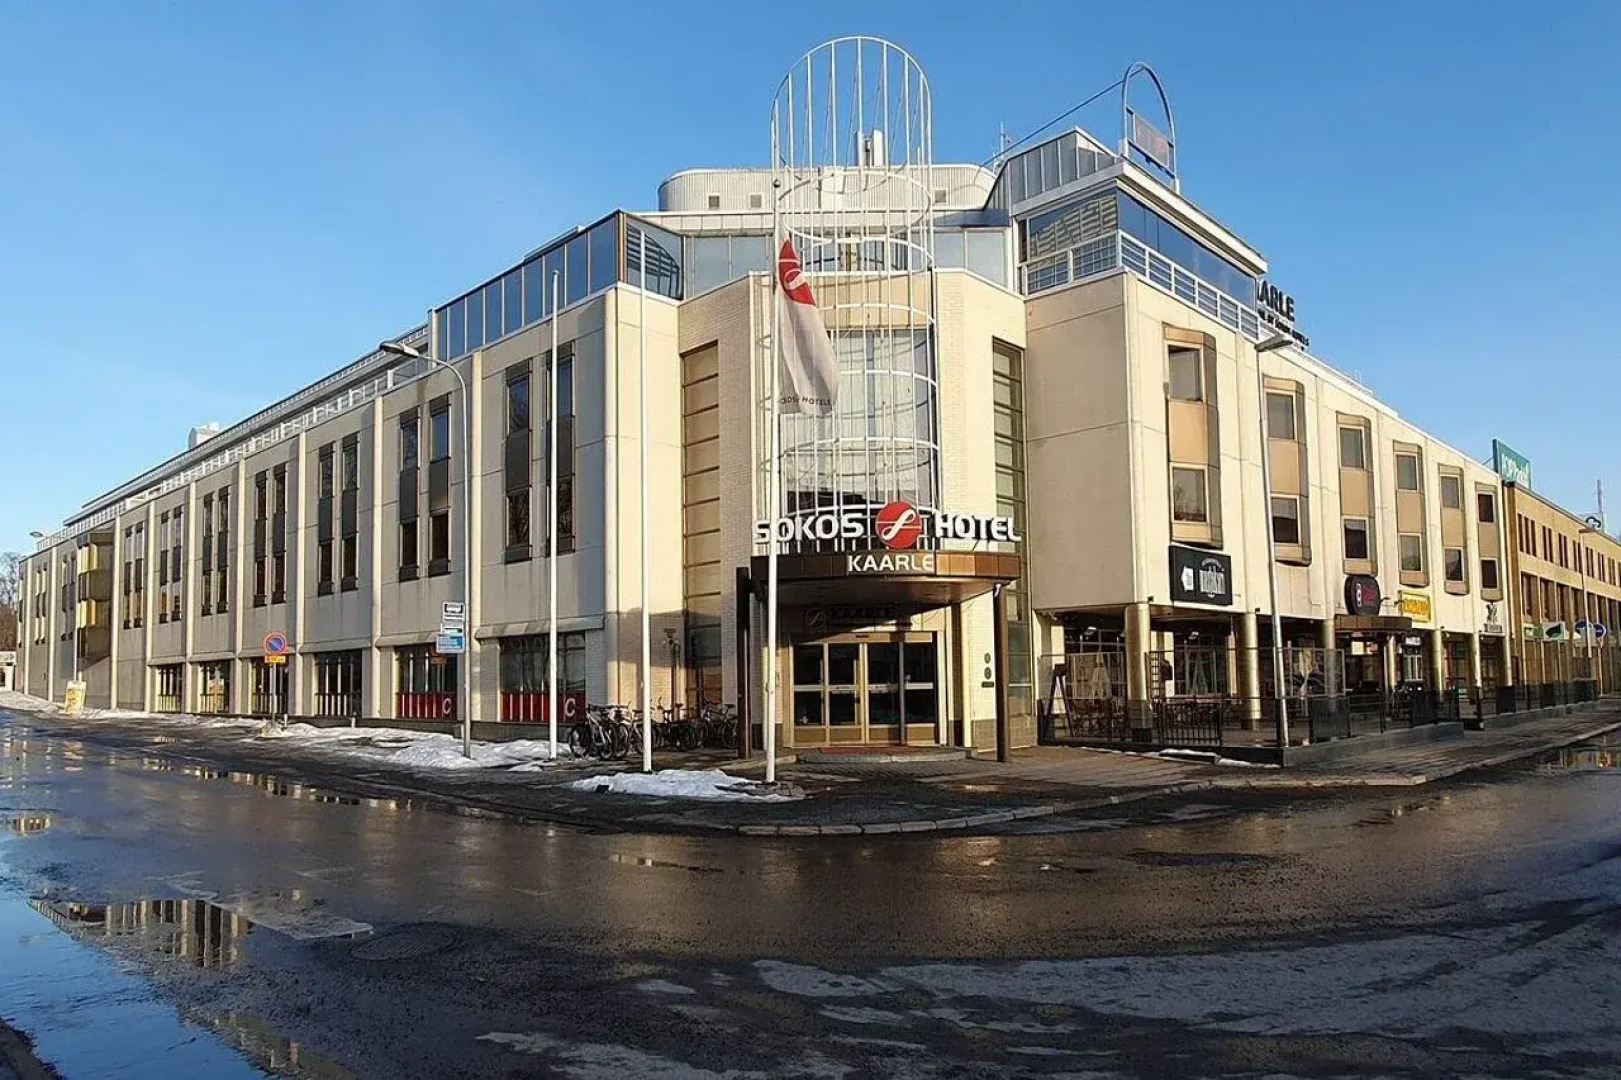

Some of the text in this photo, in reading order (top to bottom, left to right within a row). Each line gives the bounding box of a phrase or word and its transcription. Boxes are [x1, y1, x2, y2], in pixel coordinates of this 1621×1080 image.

[753, 511, 1022, 545] SOKOS HOTEL
[847, 554, 934, 573] KAARLE
